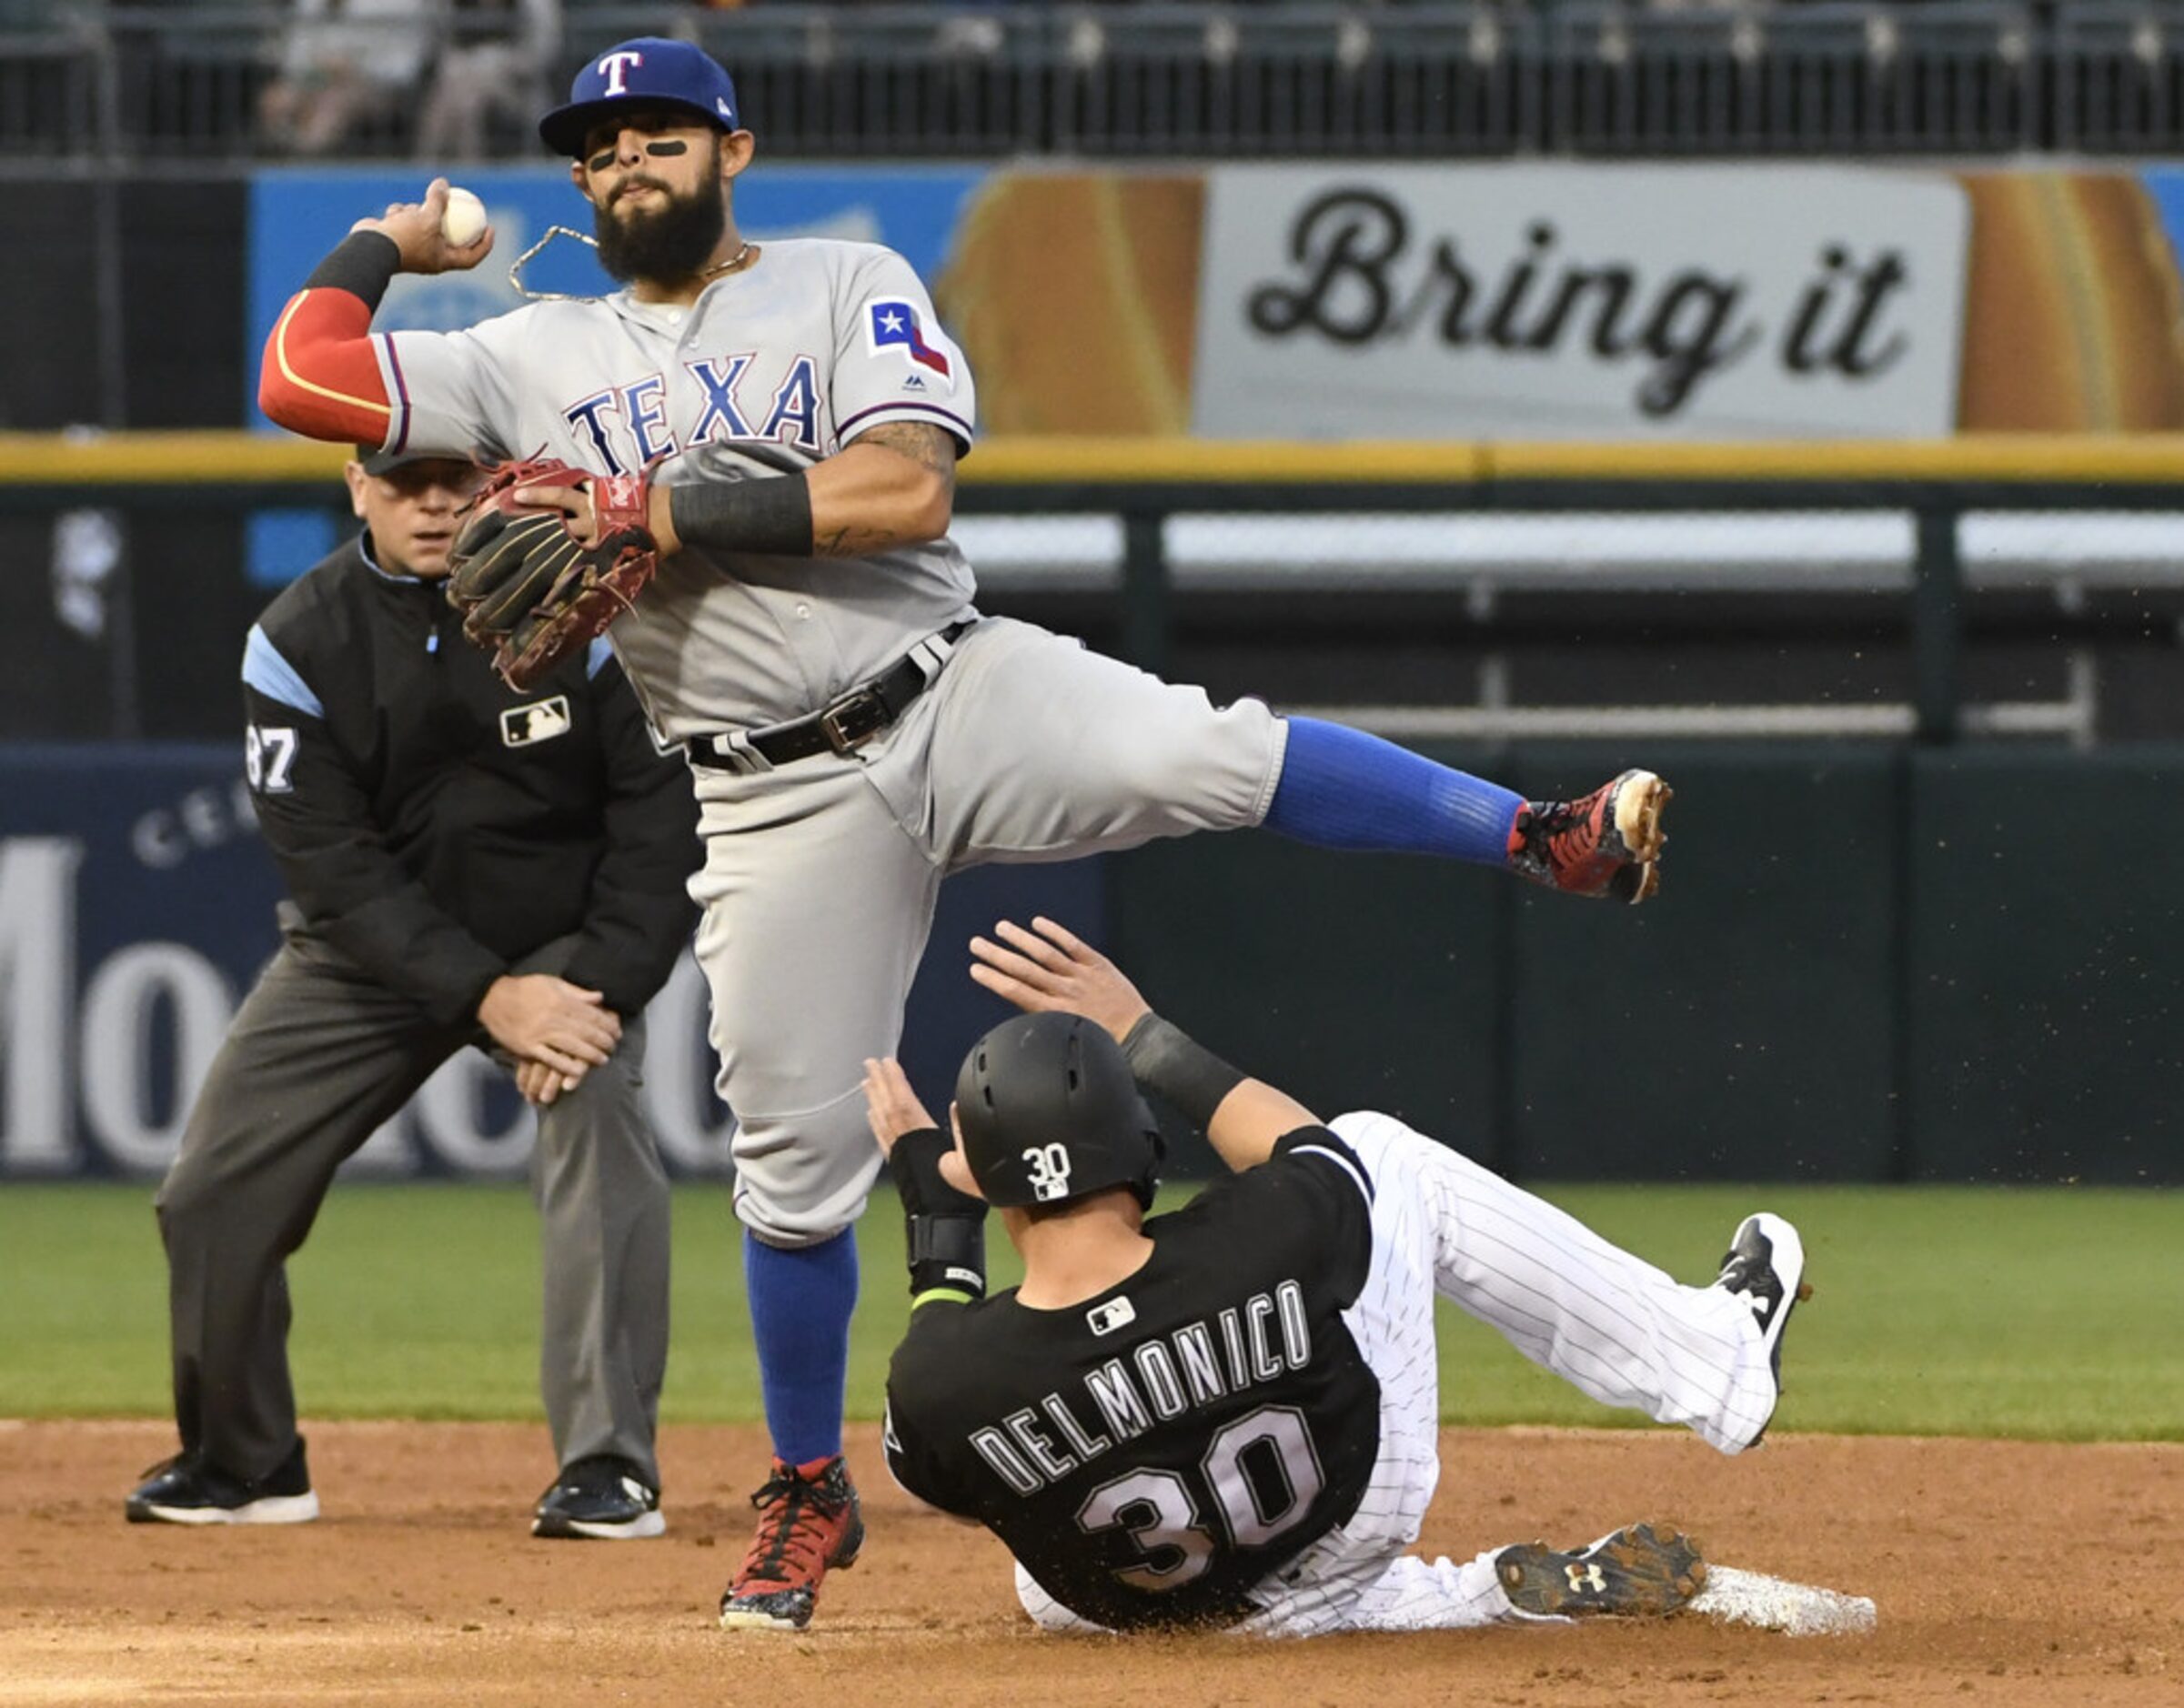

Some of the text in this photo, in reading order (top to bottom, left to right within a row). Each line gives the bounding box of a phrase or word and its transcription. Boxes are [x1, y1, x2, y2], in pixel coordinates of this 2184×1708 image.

[598, 51, 644, 97] T
[1246, 188, 1910, 418] Bring it
[561, 352, 839, 479] TEXA
[1022, 1141, 1072, 1183] 30
[969, 1279, 1312, 1497] DELMONICO
[1073, 1403, 1326, 1593] 30
